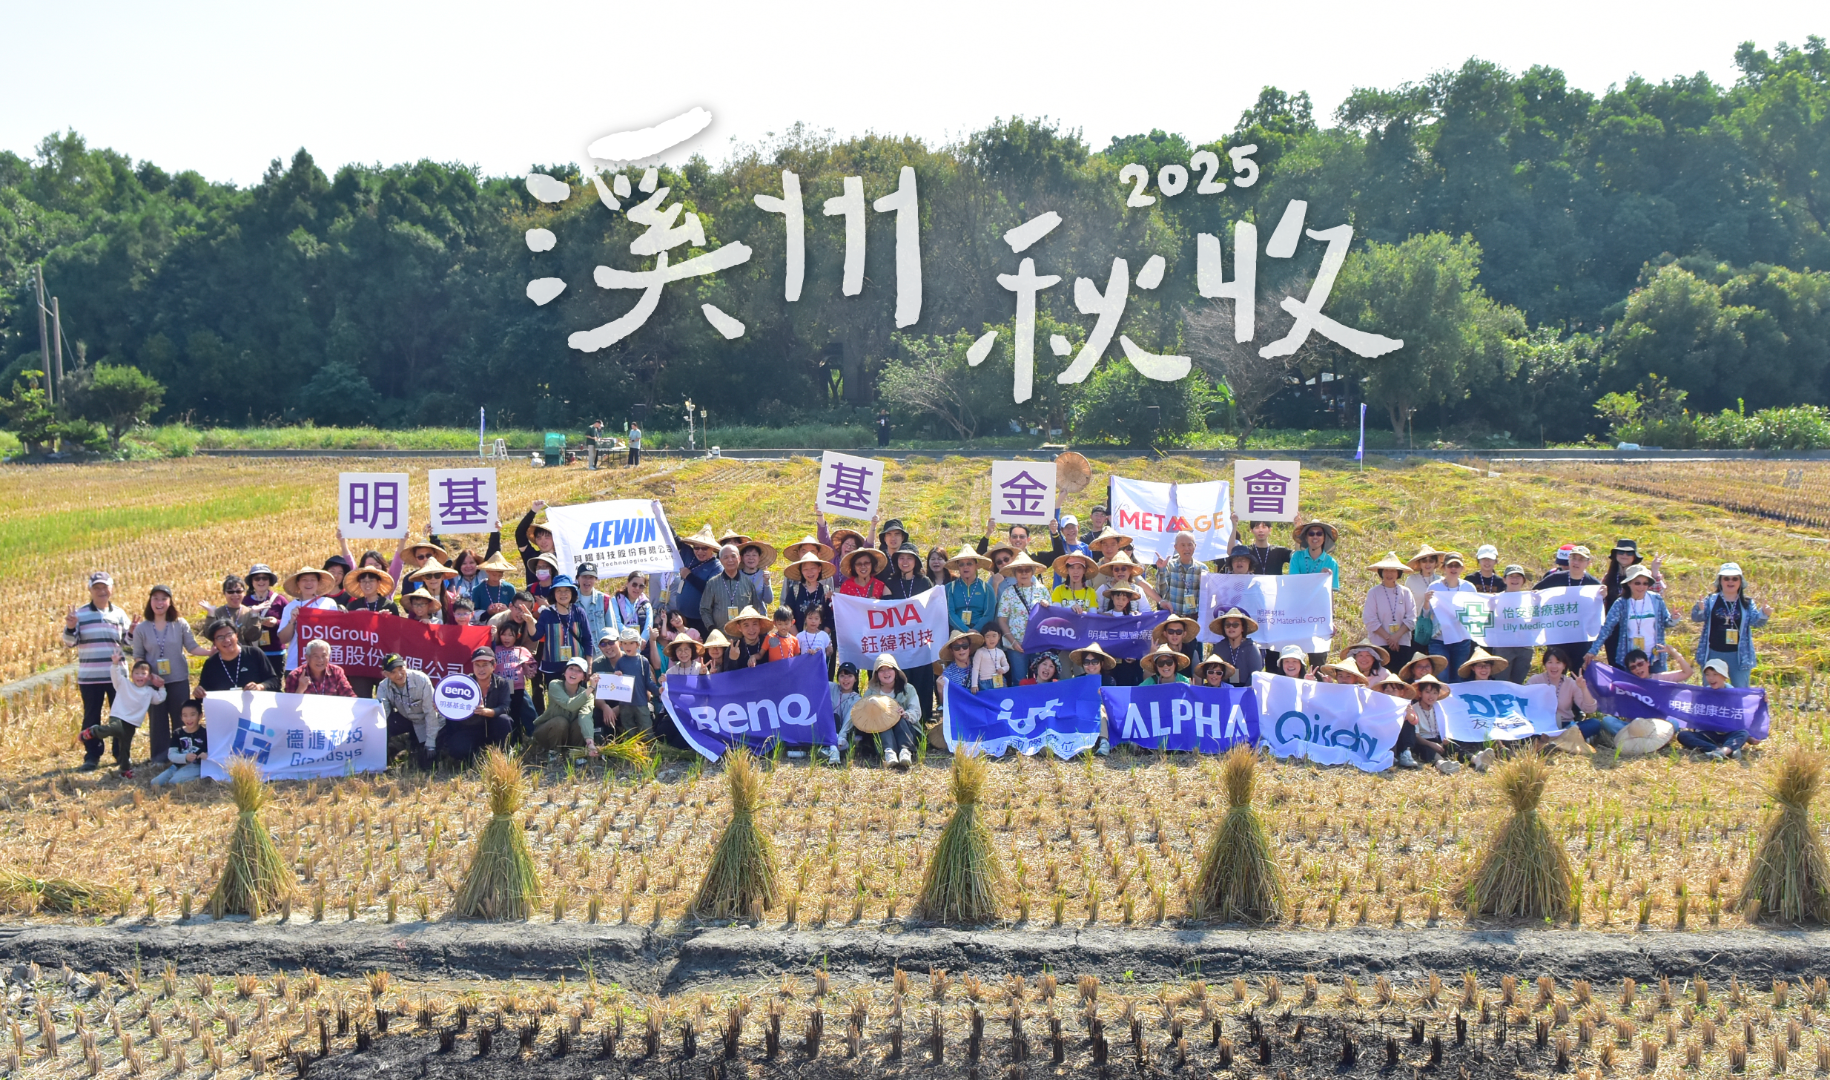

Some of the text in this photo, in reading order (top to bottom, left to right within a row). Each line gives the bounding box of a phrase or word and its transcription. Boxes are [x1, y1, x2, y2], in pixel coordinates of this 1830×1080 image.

[350, 463, 1291, 529] 明 基 基 金 會
[582, 518, 656, 550] AEWIN
[867, 603, 923, 630] DIVA
[1502, 601, 1579, 619] 怡安醫療器材
[1257, 616, 1326, 625] BenQ Materials Corp
[1503, 618, 1580, 632] Lily Medical Corp
[301, 625, 379, 644] DSIGroup
[861, 629, 934, 654] 鈺緯科技
[1039, 625, 1077, 639] BenQ
[301, 645, 465, 680] 通股份限公司
[445, 686, 472, 698] BenQ
[440, 701, 472, 711] 明基基金會
[688, 693, 817, 734] BenQ
[1669, 700, 1744, 720] 明基健康生活
[1121, 699, 1250, 739] ALPHA
